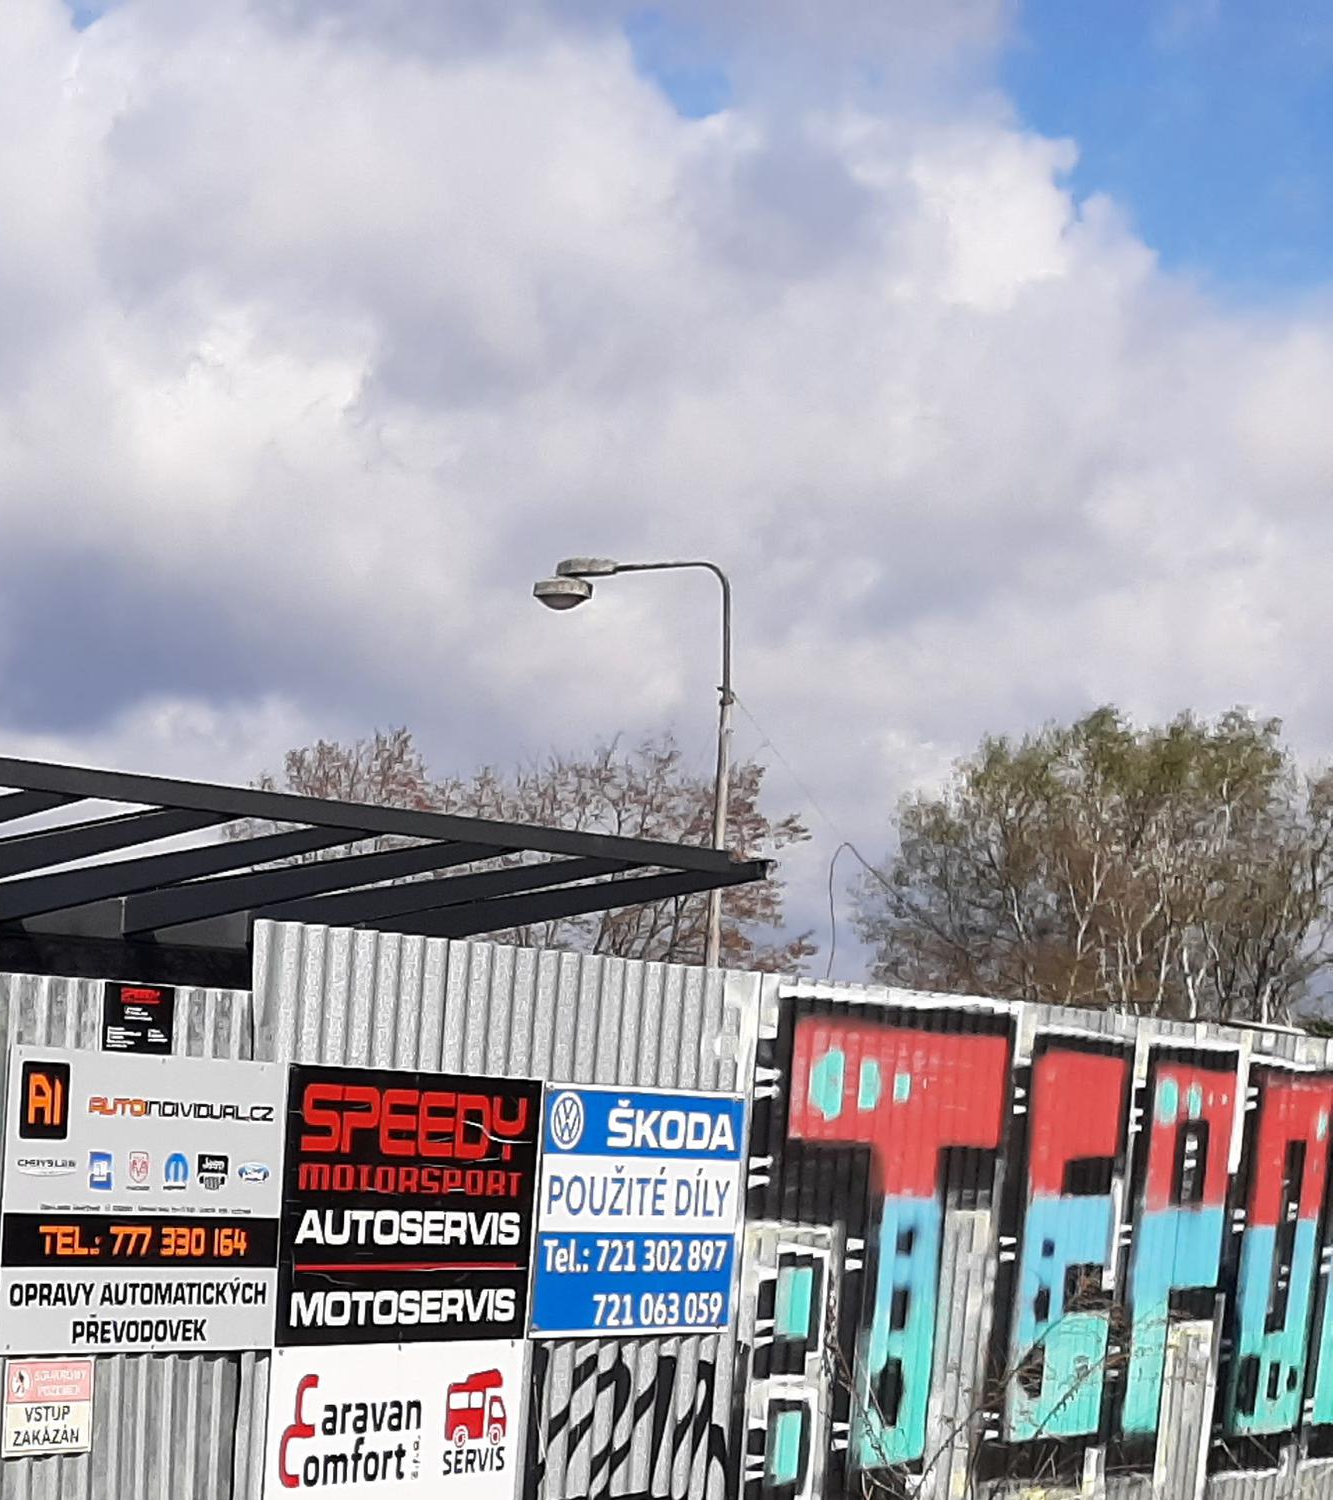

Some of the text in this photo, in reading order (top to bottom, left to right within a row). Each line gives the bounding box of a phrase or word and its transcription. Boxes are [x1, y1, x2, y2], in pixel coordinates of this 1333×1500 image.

[300, 1082, 529, 1162] SPEEDY
[606, 1099, 735, 1152] ŠKODA
[298, 1162, 523, 1198] MOTORSPORT
[546, 1165, 731, 1218] POUŽITÉ DÍLY
[109, 1225, 153, 1257] 777
[159, 1227, 206, 1257] 330
[213, 1227, 248, 1257] 164
[294, 1208, 521, 1247] AUTOSERVIS
[543, 1238, 728, 1274] Tel.: 721 302 897
[9, 1277, 268, 1308] OPRAVY AUTOMATICKÝCH
[289, 1287, 517, 1328] MOTOSERVIS
[591, 1292, 724, 1328] 721 063 059
[71, 1314, 207, 1345] PŘEVODOVEK
[24, 1405, 71, 1424] VSTUP
[294, 1373, 422, 1436] Caravan
[13, 1424, 80, 1447] ZAKÁZÁN
[278, 1423, 407, 1489] Comfort
[442, 1446, 506, 1476] SERVIS
